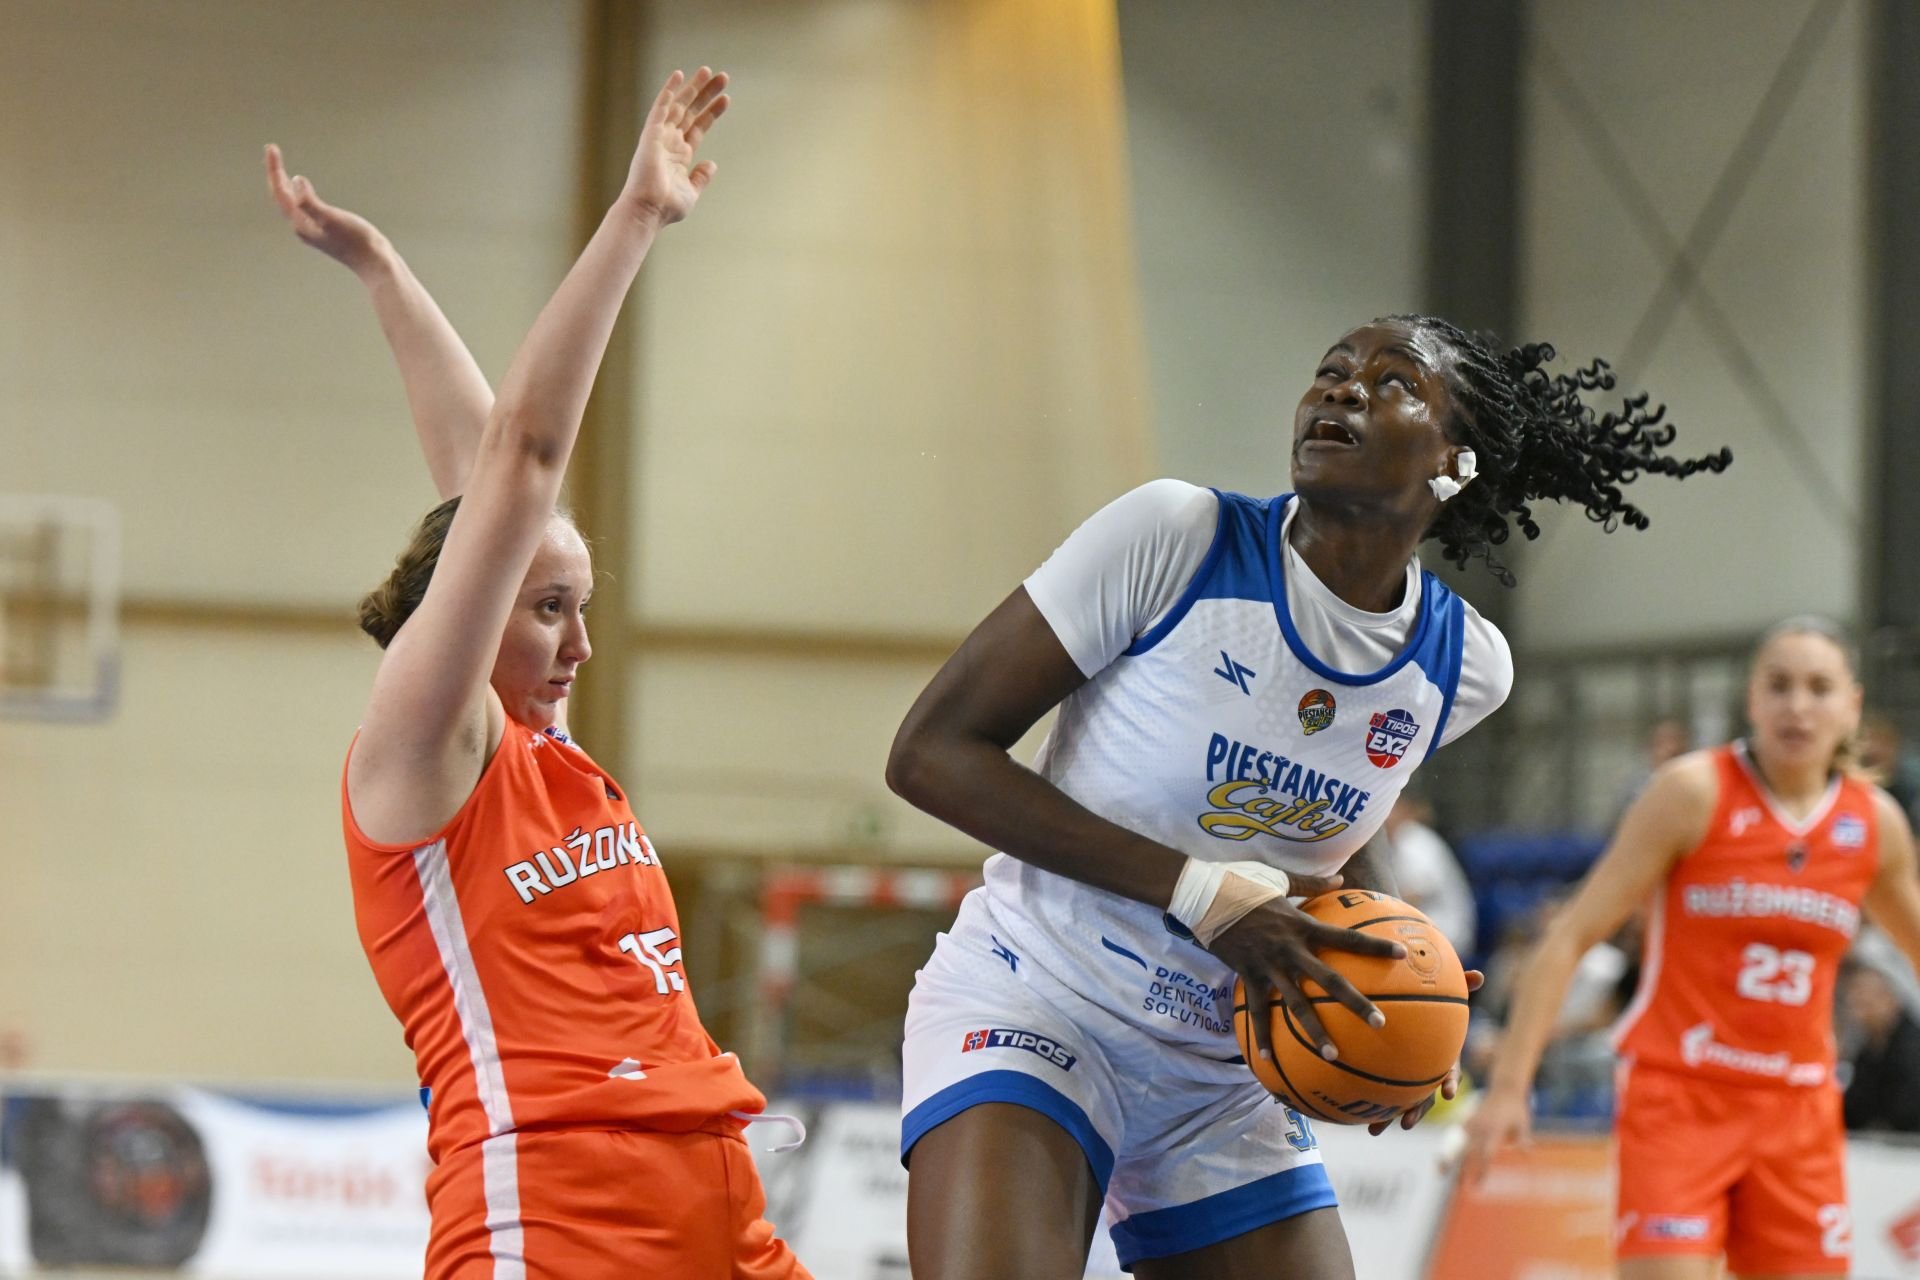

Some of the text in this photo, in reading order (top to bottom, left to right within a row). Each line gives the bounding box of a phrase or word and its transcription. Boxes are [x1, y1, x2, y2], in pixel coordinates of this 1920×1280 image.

[1367, 731, 1412, 757] EXZ
[1386, 719, 1418, 736] TIPOS
[617, 925, 685, 995] 15
[1737, 943, 1816, 1006] 23
[1143, 997, 1231, 1033] SOLUTIONS
[1149, 981, 1212, 1013] DENTAL
[994, 1030, 1071, 1066] TIPOS
